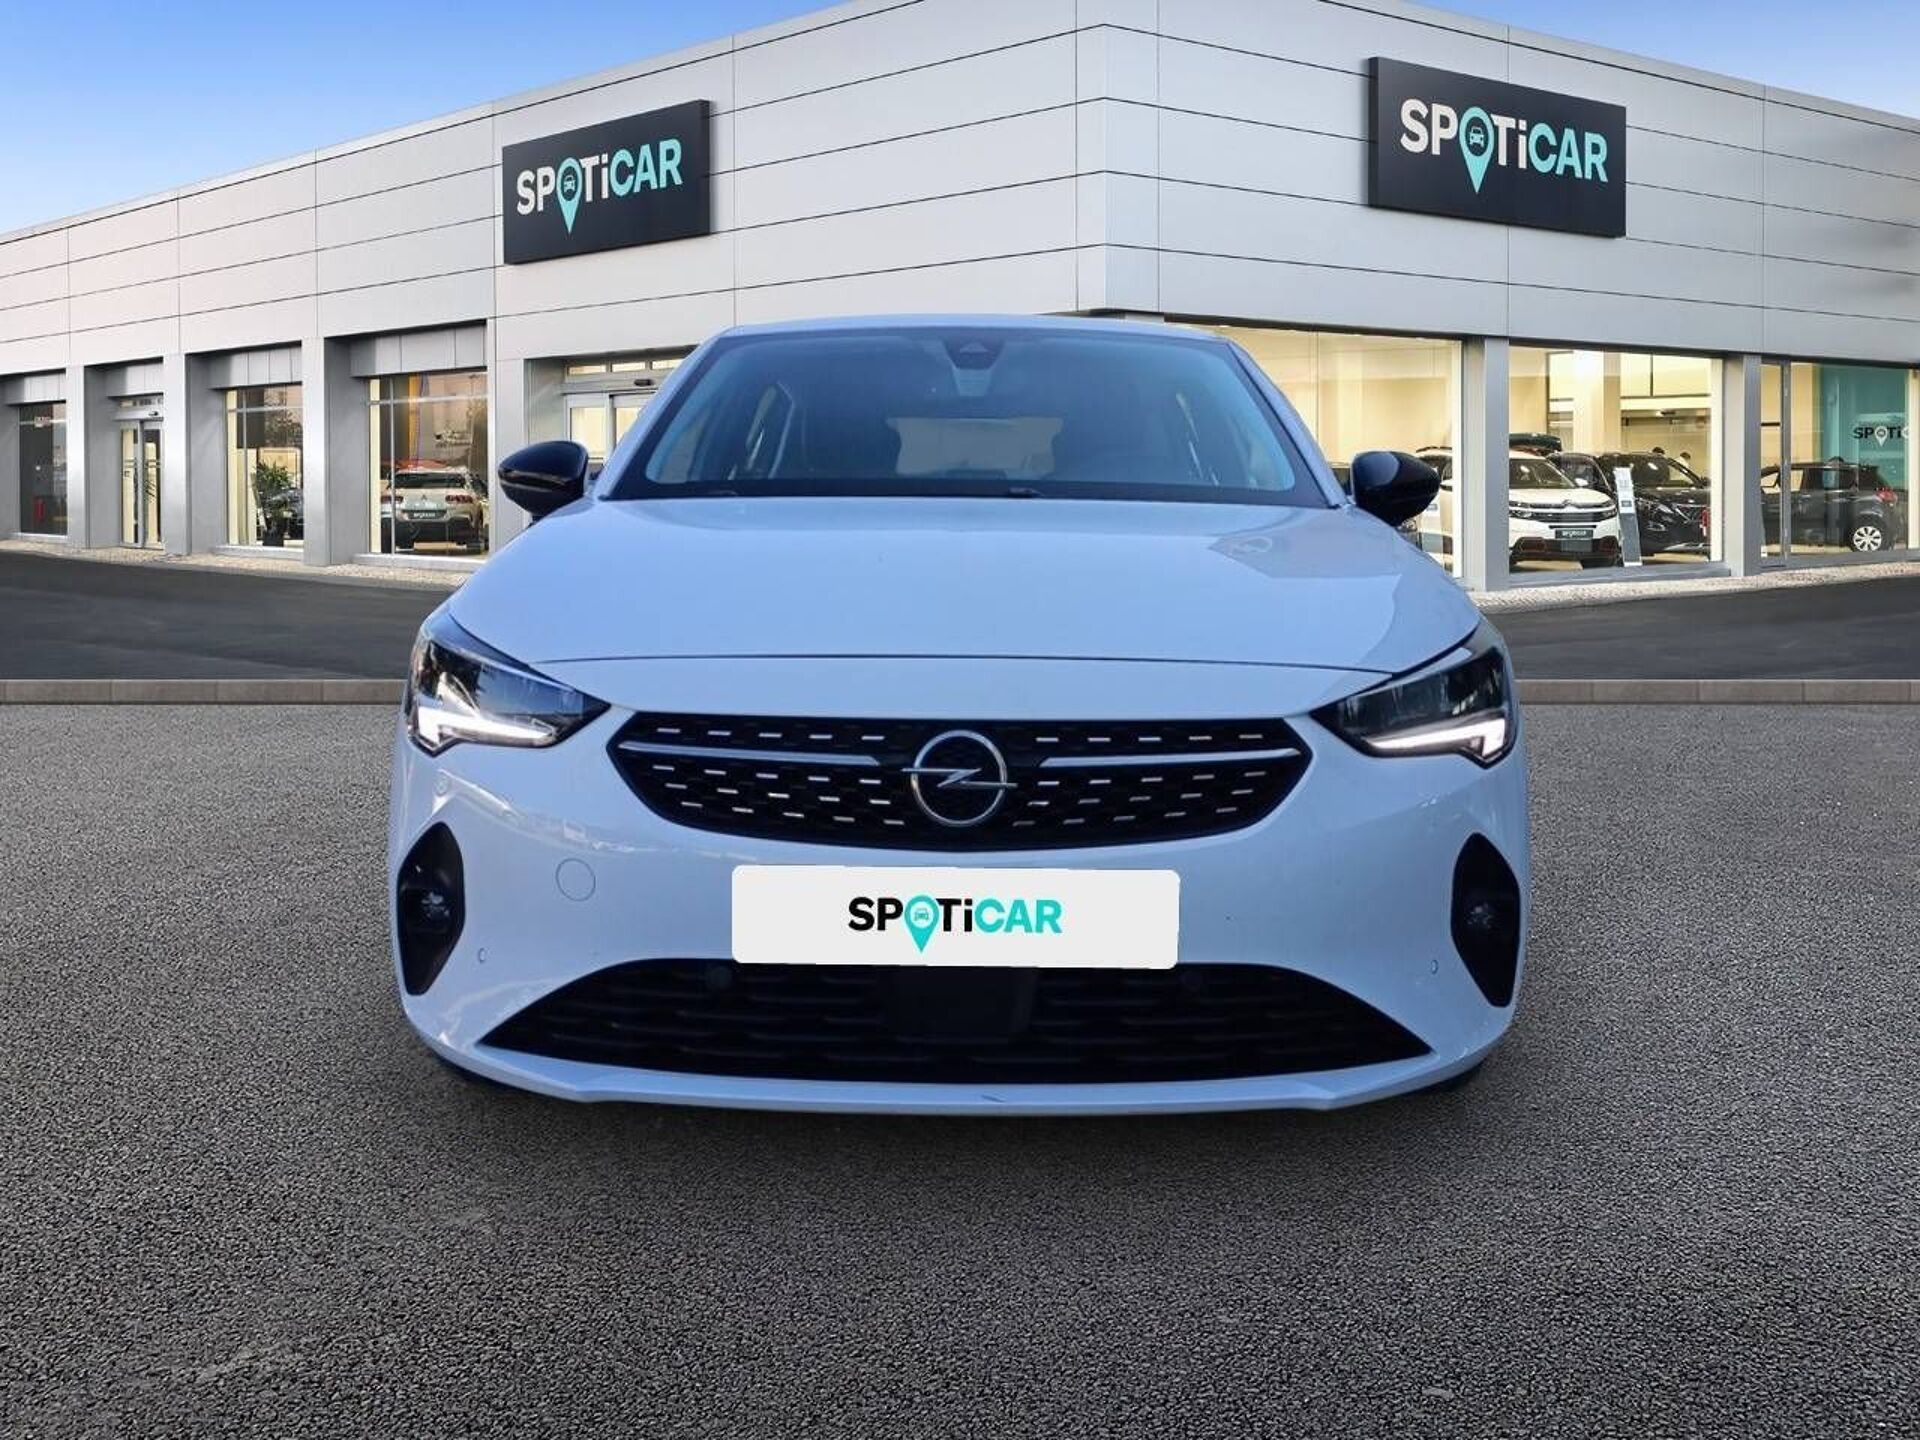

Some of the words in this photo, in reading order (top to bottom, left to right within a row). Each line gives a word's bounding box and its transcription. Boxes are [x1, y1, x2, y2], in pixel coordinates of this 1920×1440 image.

[516, 138, 683, 234] SPOTiCAR
[1400, 98, 1609, 194] SPOTiCAR
[848, 894, 1063, 953] SPOTiCAR
